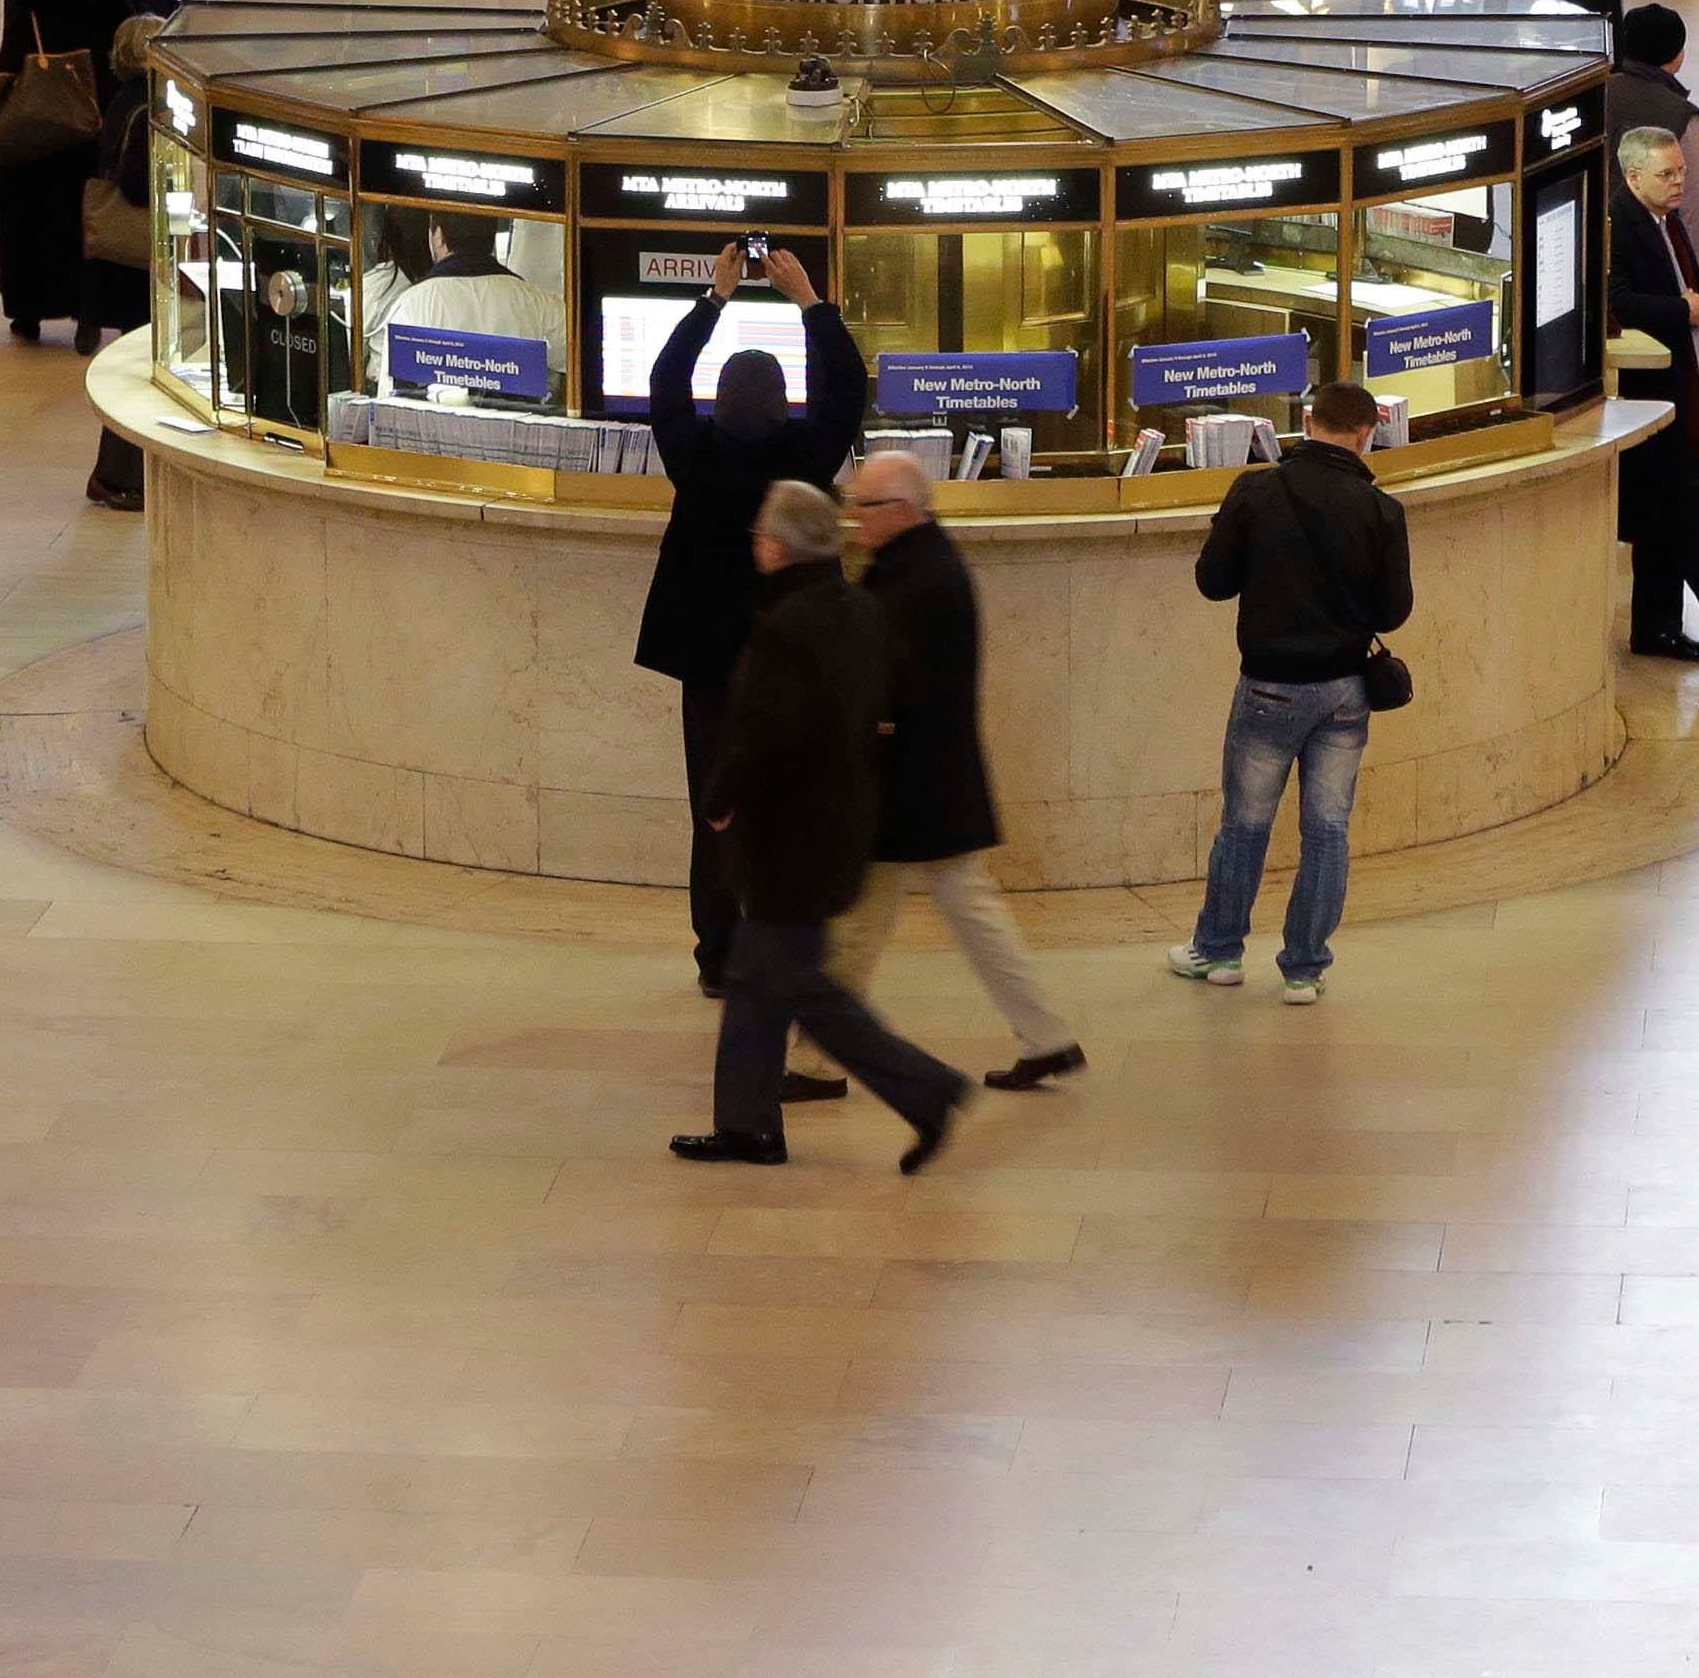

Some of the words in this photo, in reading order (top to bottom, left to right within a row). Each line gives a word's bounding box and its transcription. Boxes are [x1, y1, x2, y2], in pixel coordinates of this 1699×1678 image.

[622, 176, 660, 192] MTA
[661, 177, 788, 198] METRO-NORTH
[664, 193, 745, 212] ARRIVALS
[647, 257, 748, 279] ARRIV
[271, 329, 317, 354] CLOSED
[1389, 340, 1413, 355] New
[1413, 328, 1472, 351] Metro-North
[416, 351, 443, 367] New
[445, 354, 519, 375] Metro-North
[1404, 350, 1457, 369] Timetables
[434, 370, 501, 391] Timetables
[1164, 369, 1194, 383] New
[1197, 361, 1276, 381] Metro-North
[913, 378, 947, 392] New
[950, 377, 1041, 392] Metro-North
[1184, 382, 1256, 399] Timetables
[936, 396, 1018, 409] Timetables
